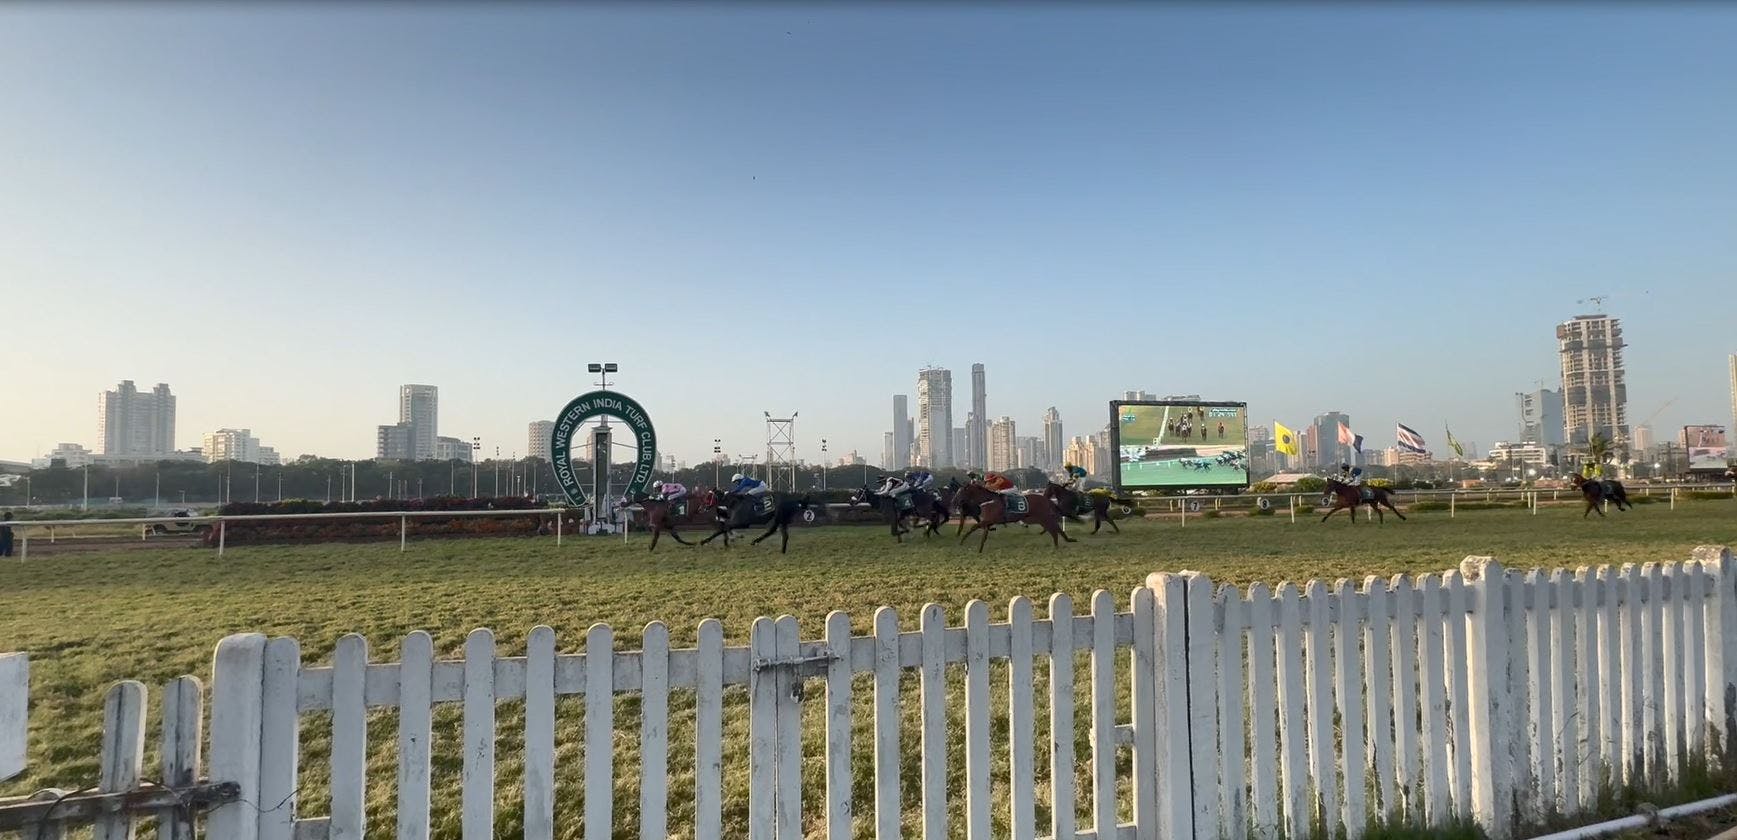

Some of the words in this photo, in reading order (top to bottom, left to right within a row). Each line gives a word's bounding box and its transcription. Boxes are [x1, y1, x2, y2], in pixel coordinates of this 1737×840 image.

[593, 398, 622, 411] INDIA
[556, 402, 591, 448] WESTERN
[625, 405, 648, 429] TURF
[556, 451, 574, 486] ROYAL
[634, 464, 650, 483] LTD.
[678, 505, 685, 515] 1
[763, 501, 772, 511] 2
